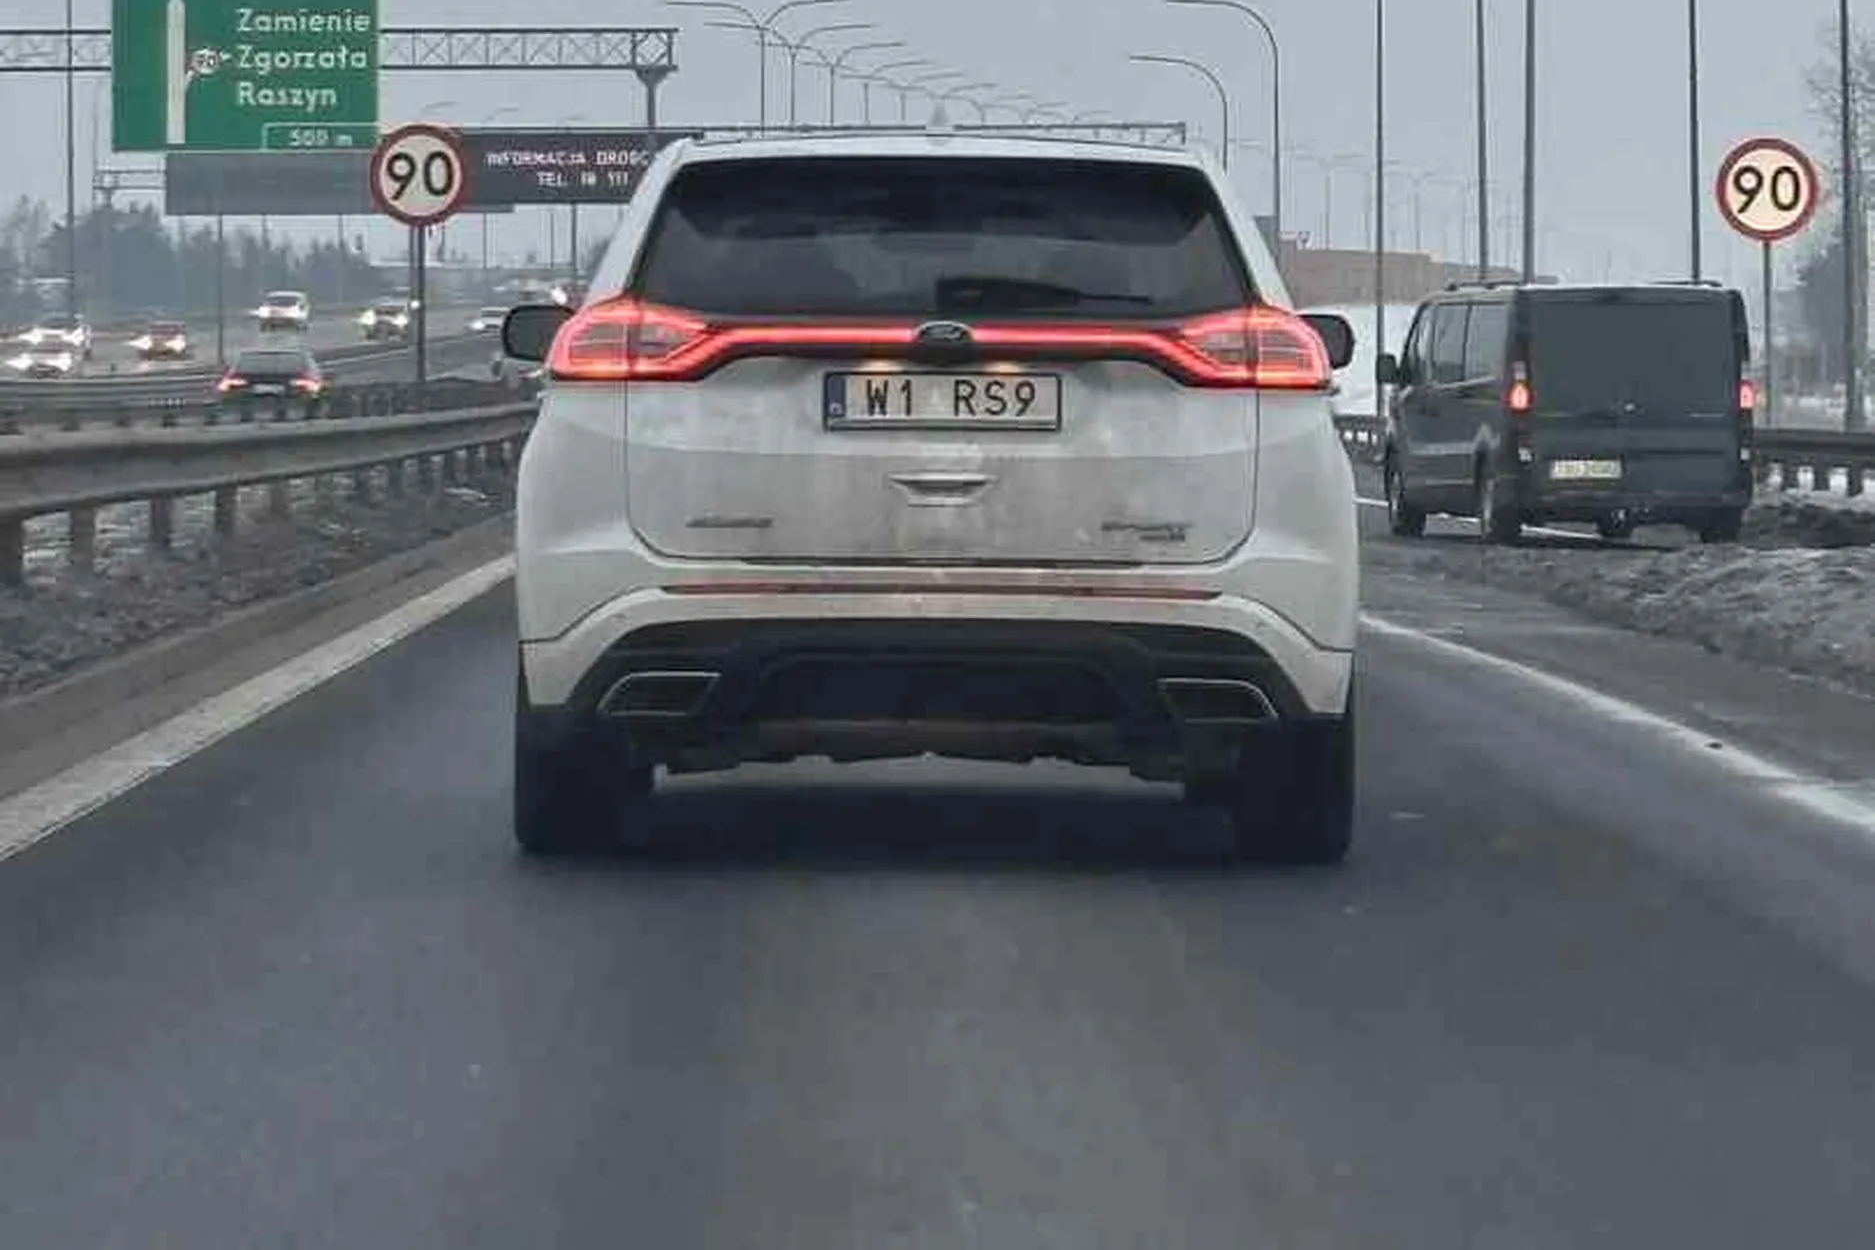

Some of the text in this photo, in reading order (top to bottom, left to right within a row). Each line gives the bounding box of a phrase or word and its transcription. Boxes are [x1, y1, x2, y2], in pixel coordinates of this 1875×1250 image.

[236, 8, 371, 32] Zamienie
[236, 45, 367, 75] Zgorzała
[237, 82, 337, 112] Raszyn
[386, 151, 452, 200] 90
[1733, 165, 1800, 213] 90
[866, 379, 1036, 417] W1 RS9
